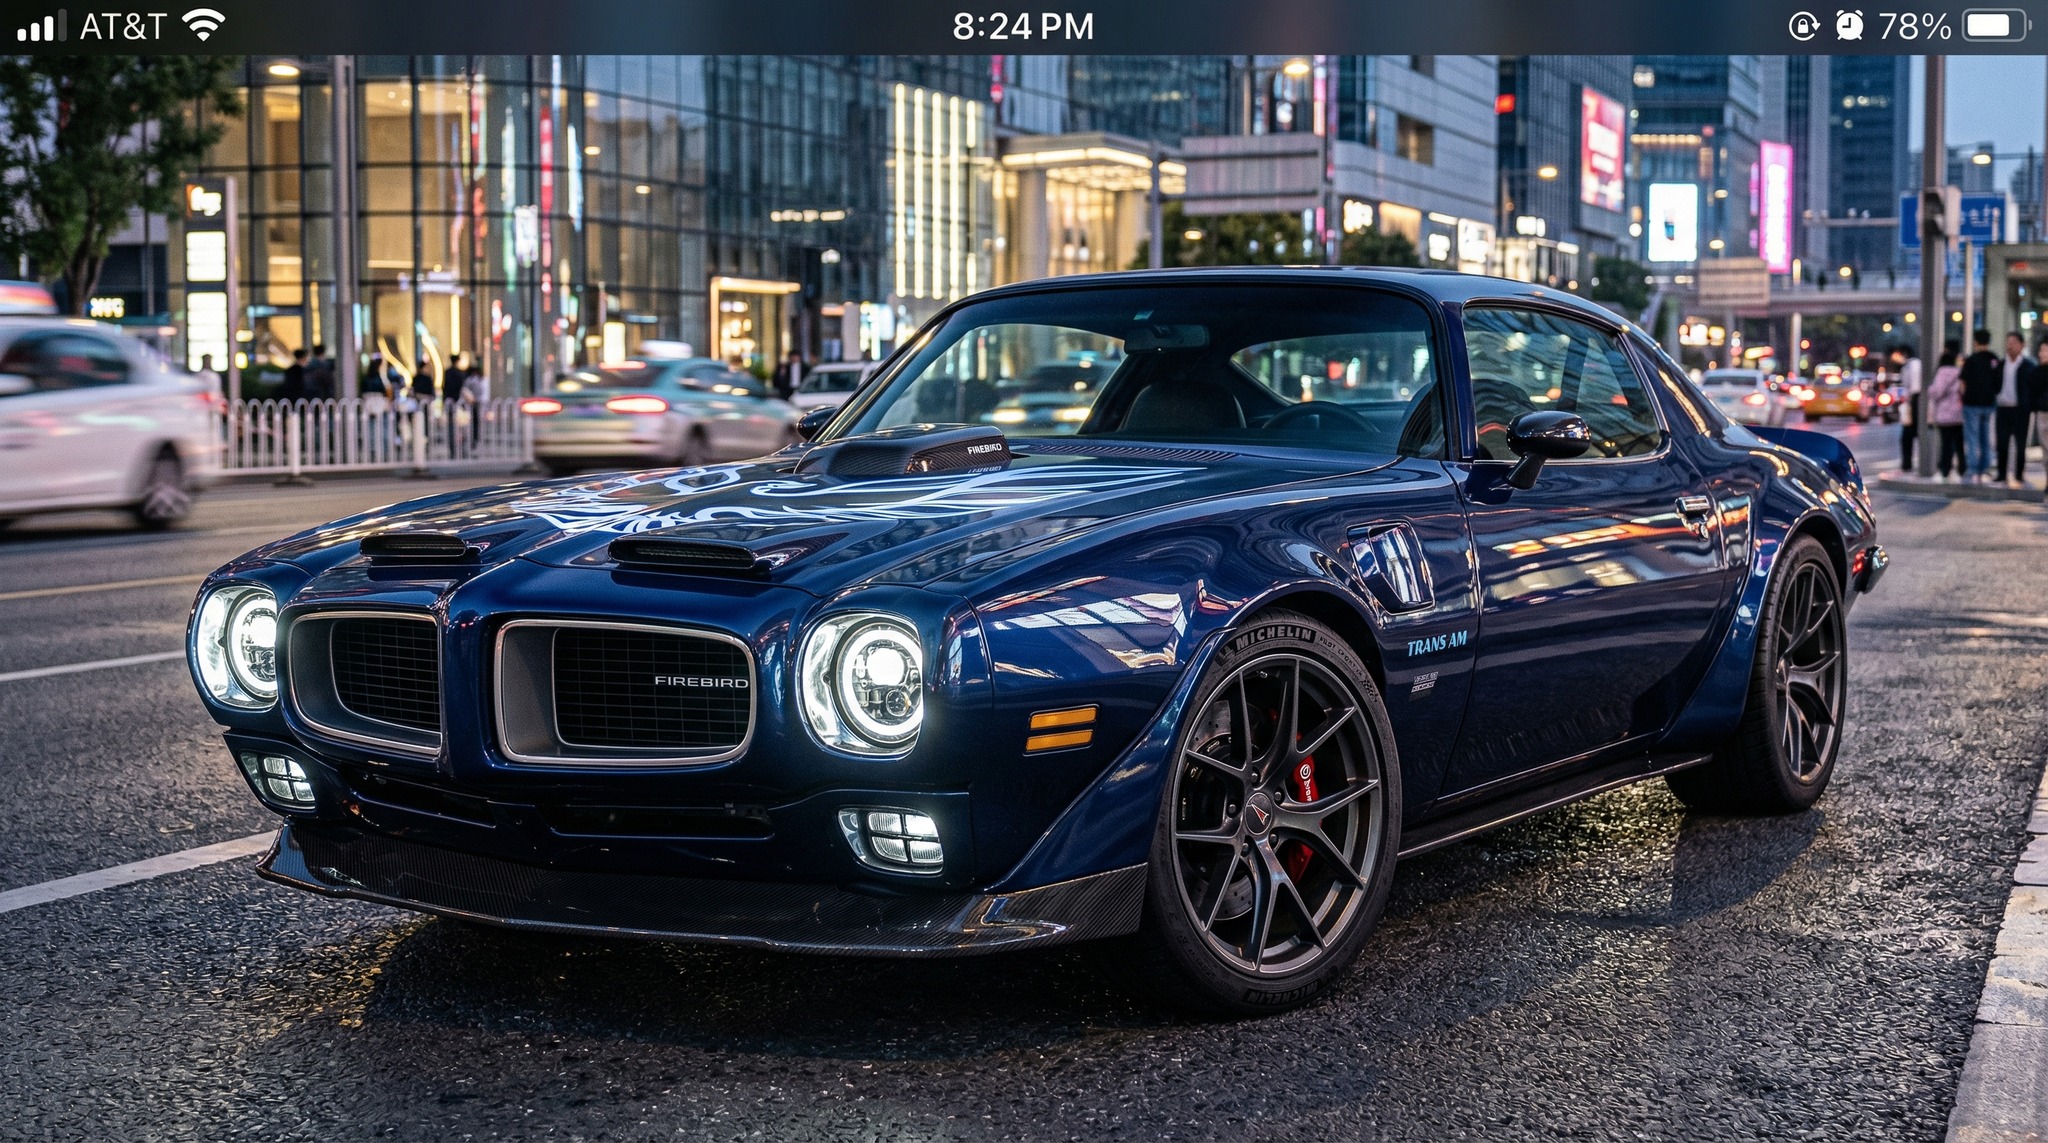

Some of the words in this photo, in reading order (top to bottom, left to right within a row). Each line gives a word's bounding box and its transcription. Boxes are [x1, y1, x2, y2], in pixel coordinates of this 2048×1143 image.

[966, 443, 1003, 455] FIREBIRD
[1235, 625, 1312, 651] MICHELIN
[1407, 634, 1447, 657] TRANS
[1448, 630, 1468, 649] AM
[654, 675, 749, 689] FIREBIRD
